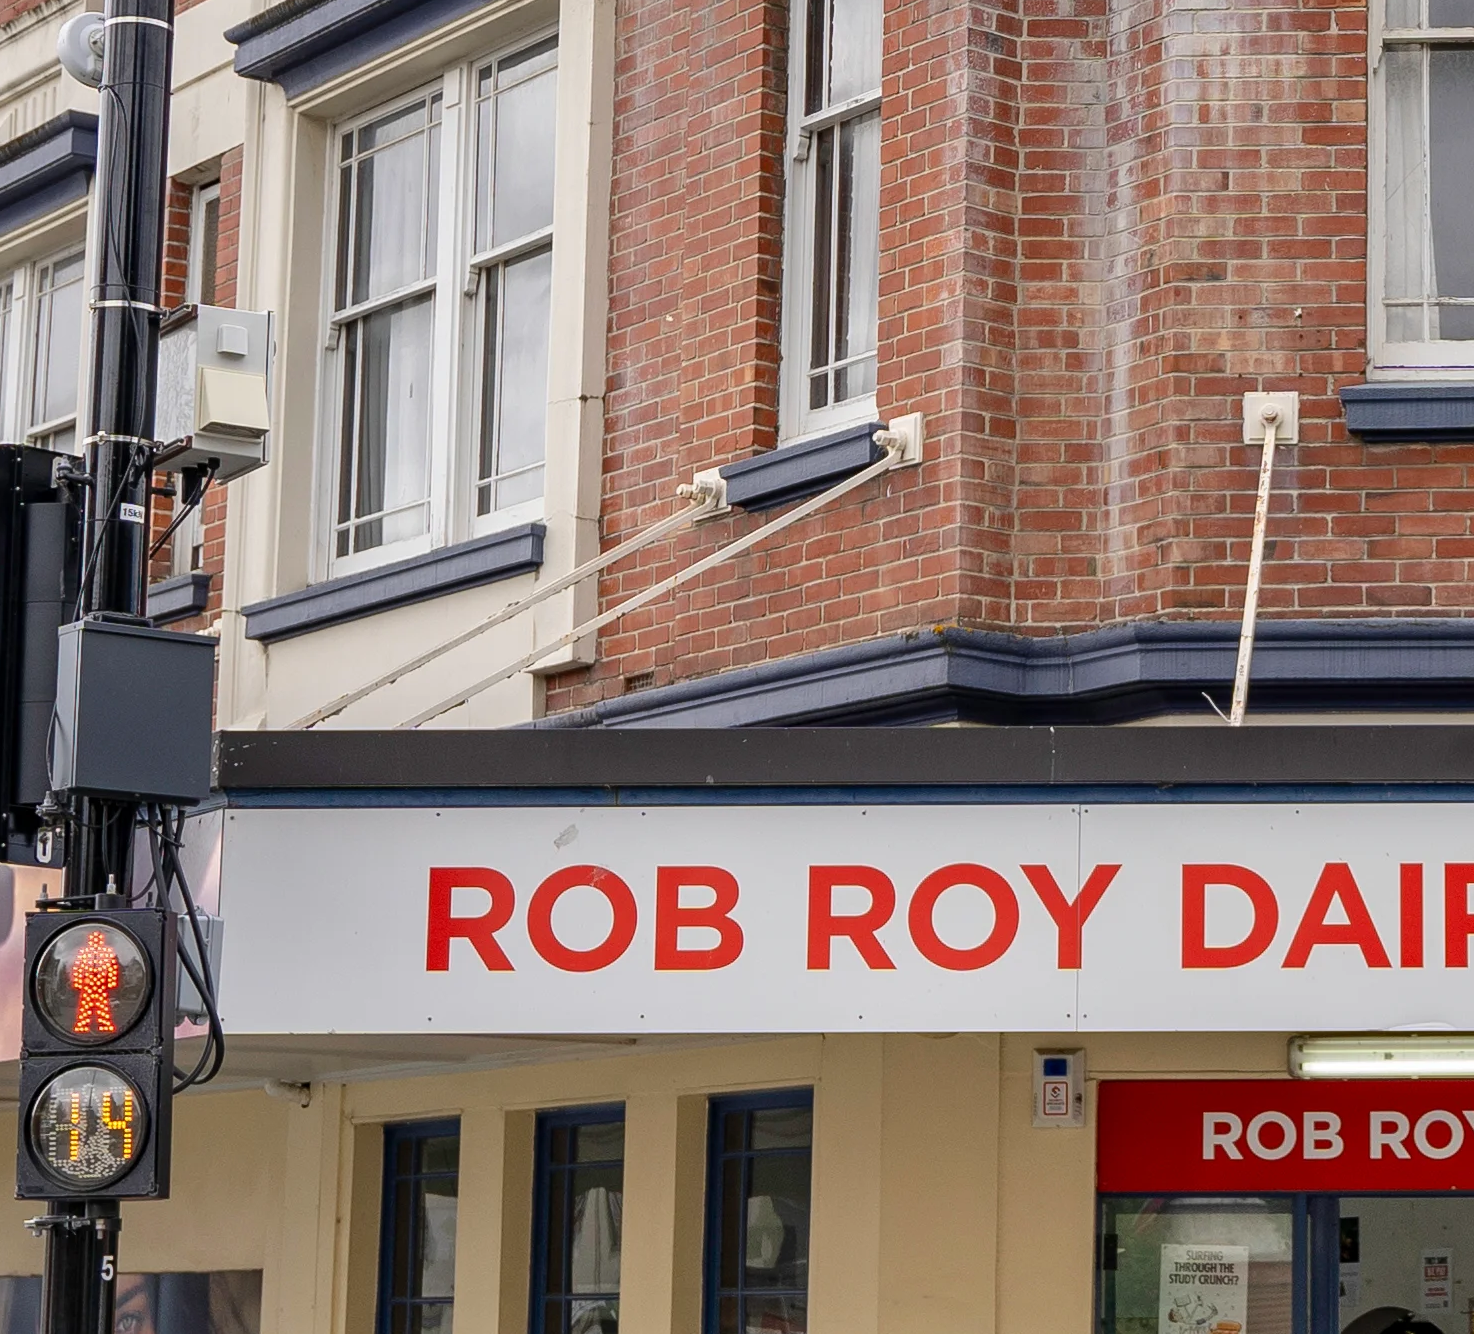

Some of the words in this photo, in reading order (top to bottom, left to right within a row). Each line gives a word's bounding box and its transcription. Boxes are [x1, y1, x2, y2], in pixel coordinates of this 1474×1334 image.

[425, 863, 745, 973] ROB
[806, 863, 1123, 973] ROY
[70, 1090, 133, 1161] 14
[1201, 1110, 1345, 1161] ROB
[100, 1255, 114, 1281] 5
[1174, 1261, 1217, 1273] THROUGH
[1219, 1263, 1235, 1273] THE
[1186, 1250, 1223, 1262] SURFING
[1169, 1273, 1197, 1285] STUDY
[1198, 1274, 1239, 1285] CRUNCH?
